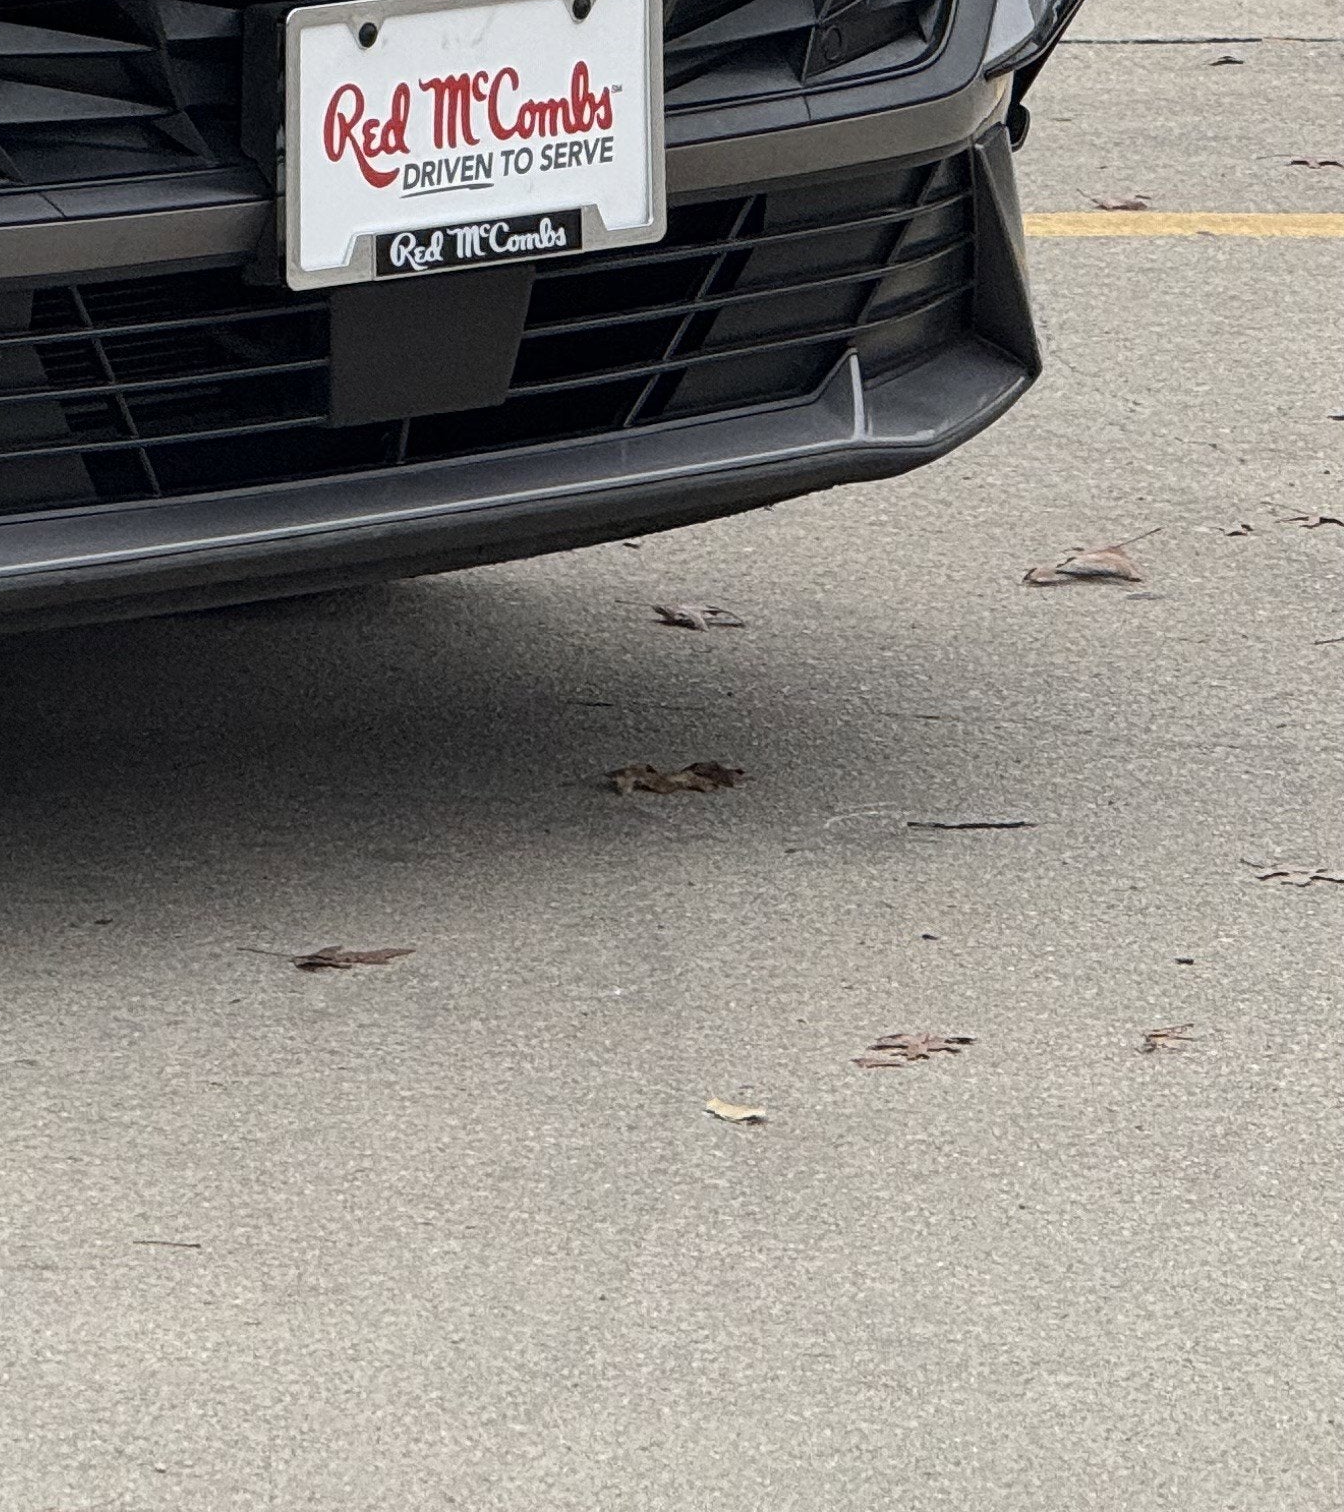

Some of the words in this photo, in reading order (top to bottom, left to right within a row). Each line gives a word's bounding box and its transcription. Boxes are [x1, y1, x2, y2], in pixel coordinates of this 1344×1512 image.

[323, 82, 411, 188] Red
[418, 60, 614, 149] McCombs
[401, 152, 494, 191] DRIVEN
[499, 147, 533, 178] TO
[538, 134, 614, 172] SERVE
[390, 231, 444, 271] Red
[450, 216, 568, 256] McCombs
